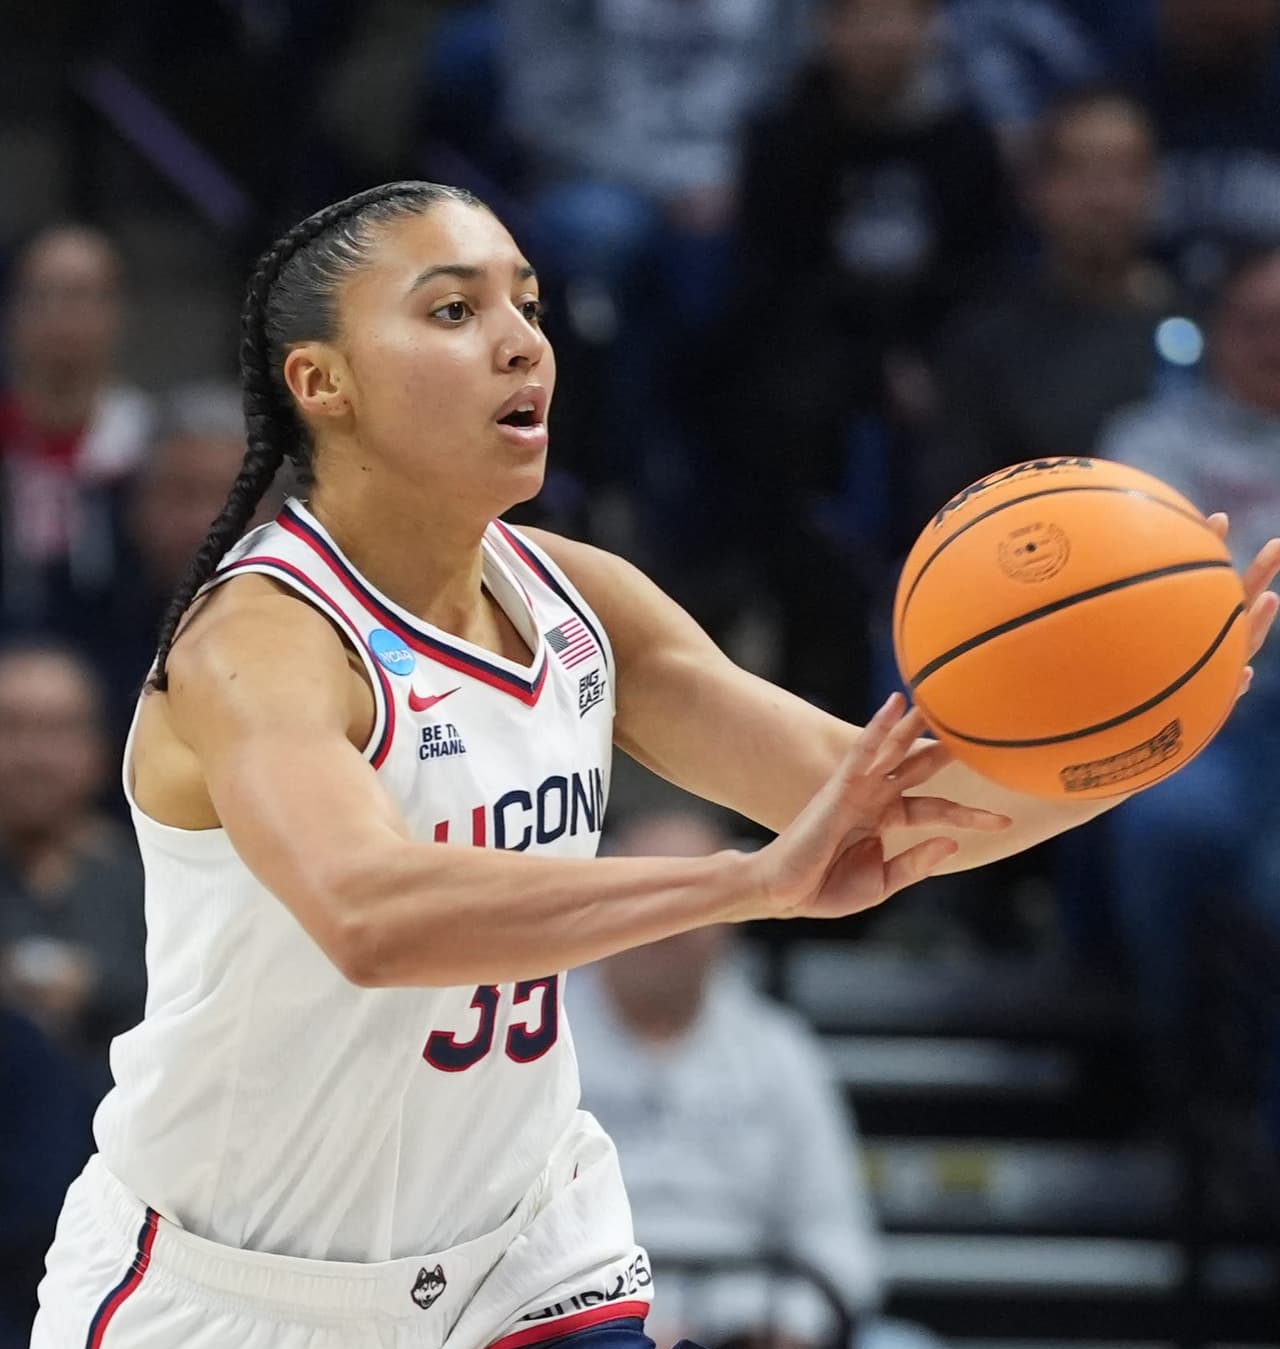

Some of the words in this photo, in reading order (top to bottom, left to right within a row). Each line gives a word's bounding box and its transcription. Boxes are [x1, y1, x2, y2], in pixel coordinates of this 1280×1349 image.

[579, 669, 600, 693] BIG
[579, 680, 606, 709] EAST
[422, 725, 442, 743] BE
